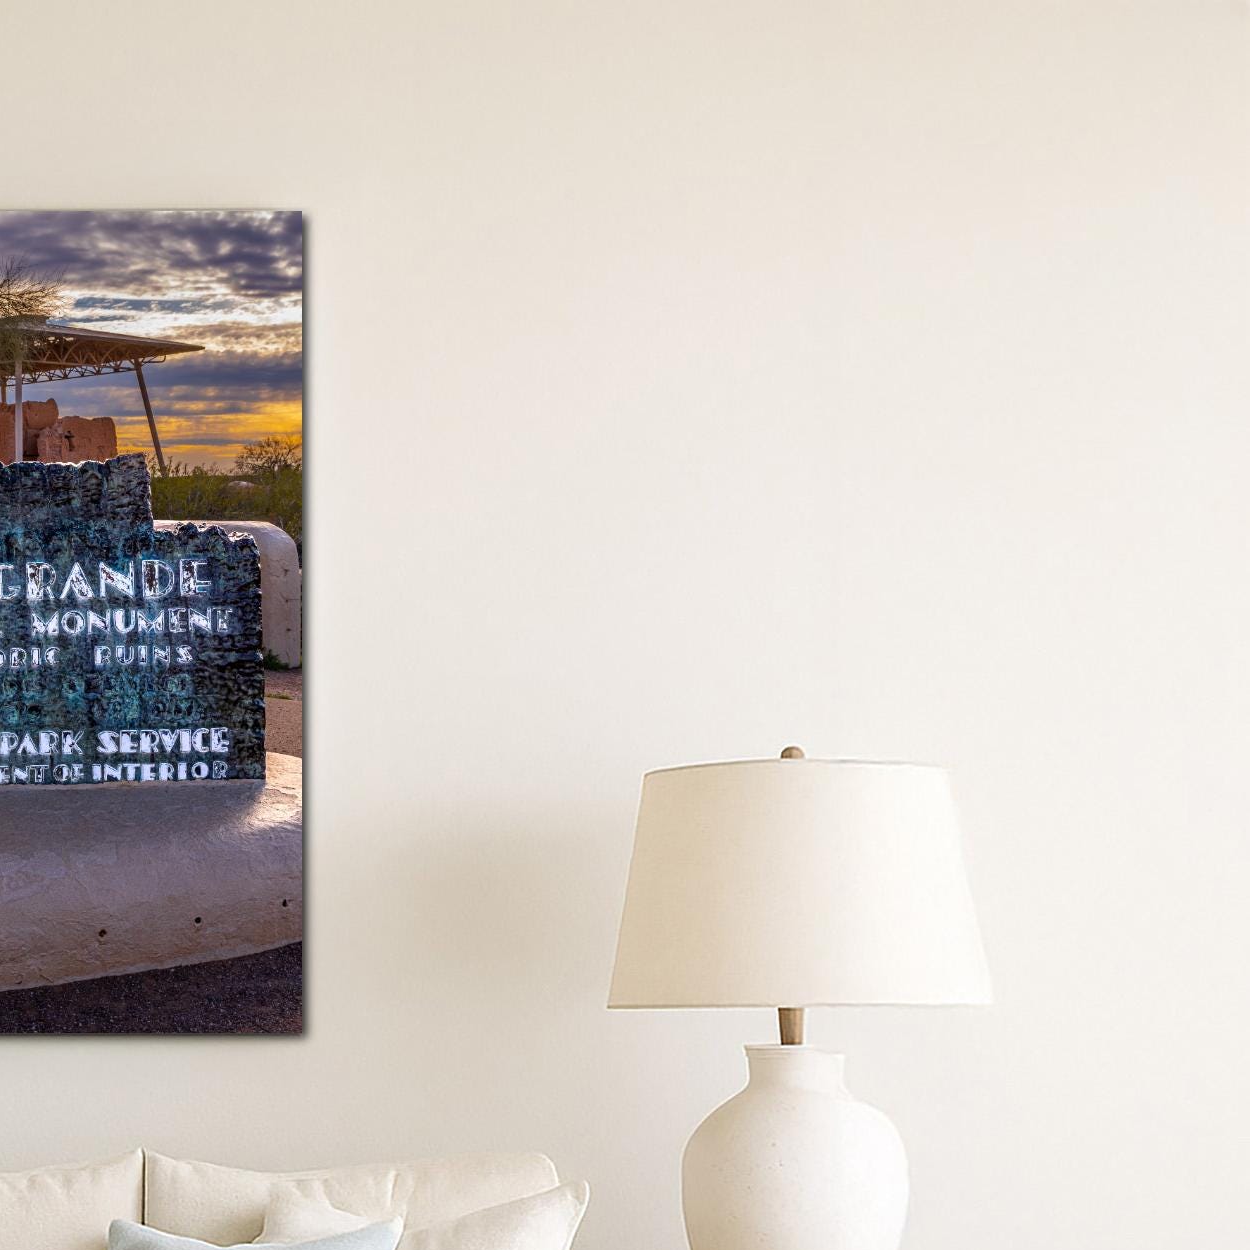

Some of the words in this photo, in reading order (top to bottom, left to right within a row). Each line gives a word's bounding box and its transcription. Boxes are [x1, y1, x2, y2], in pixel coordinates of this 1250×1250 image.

[31, 607, 233, 636] MONUMENT
[94, 644, 193, 666] RUINS
[0, 730, 84, 755] PARK
[96, 727, 229, 754] SERVICE
[53, 763, 84, 783] OF
[92, 761, 228, 781] INTERIOR
